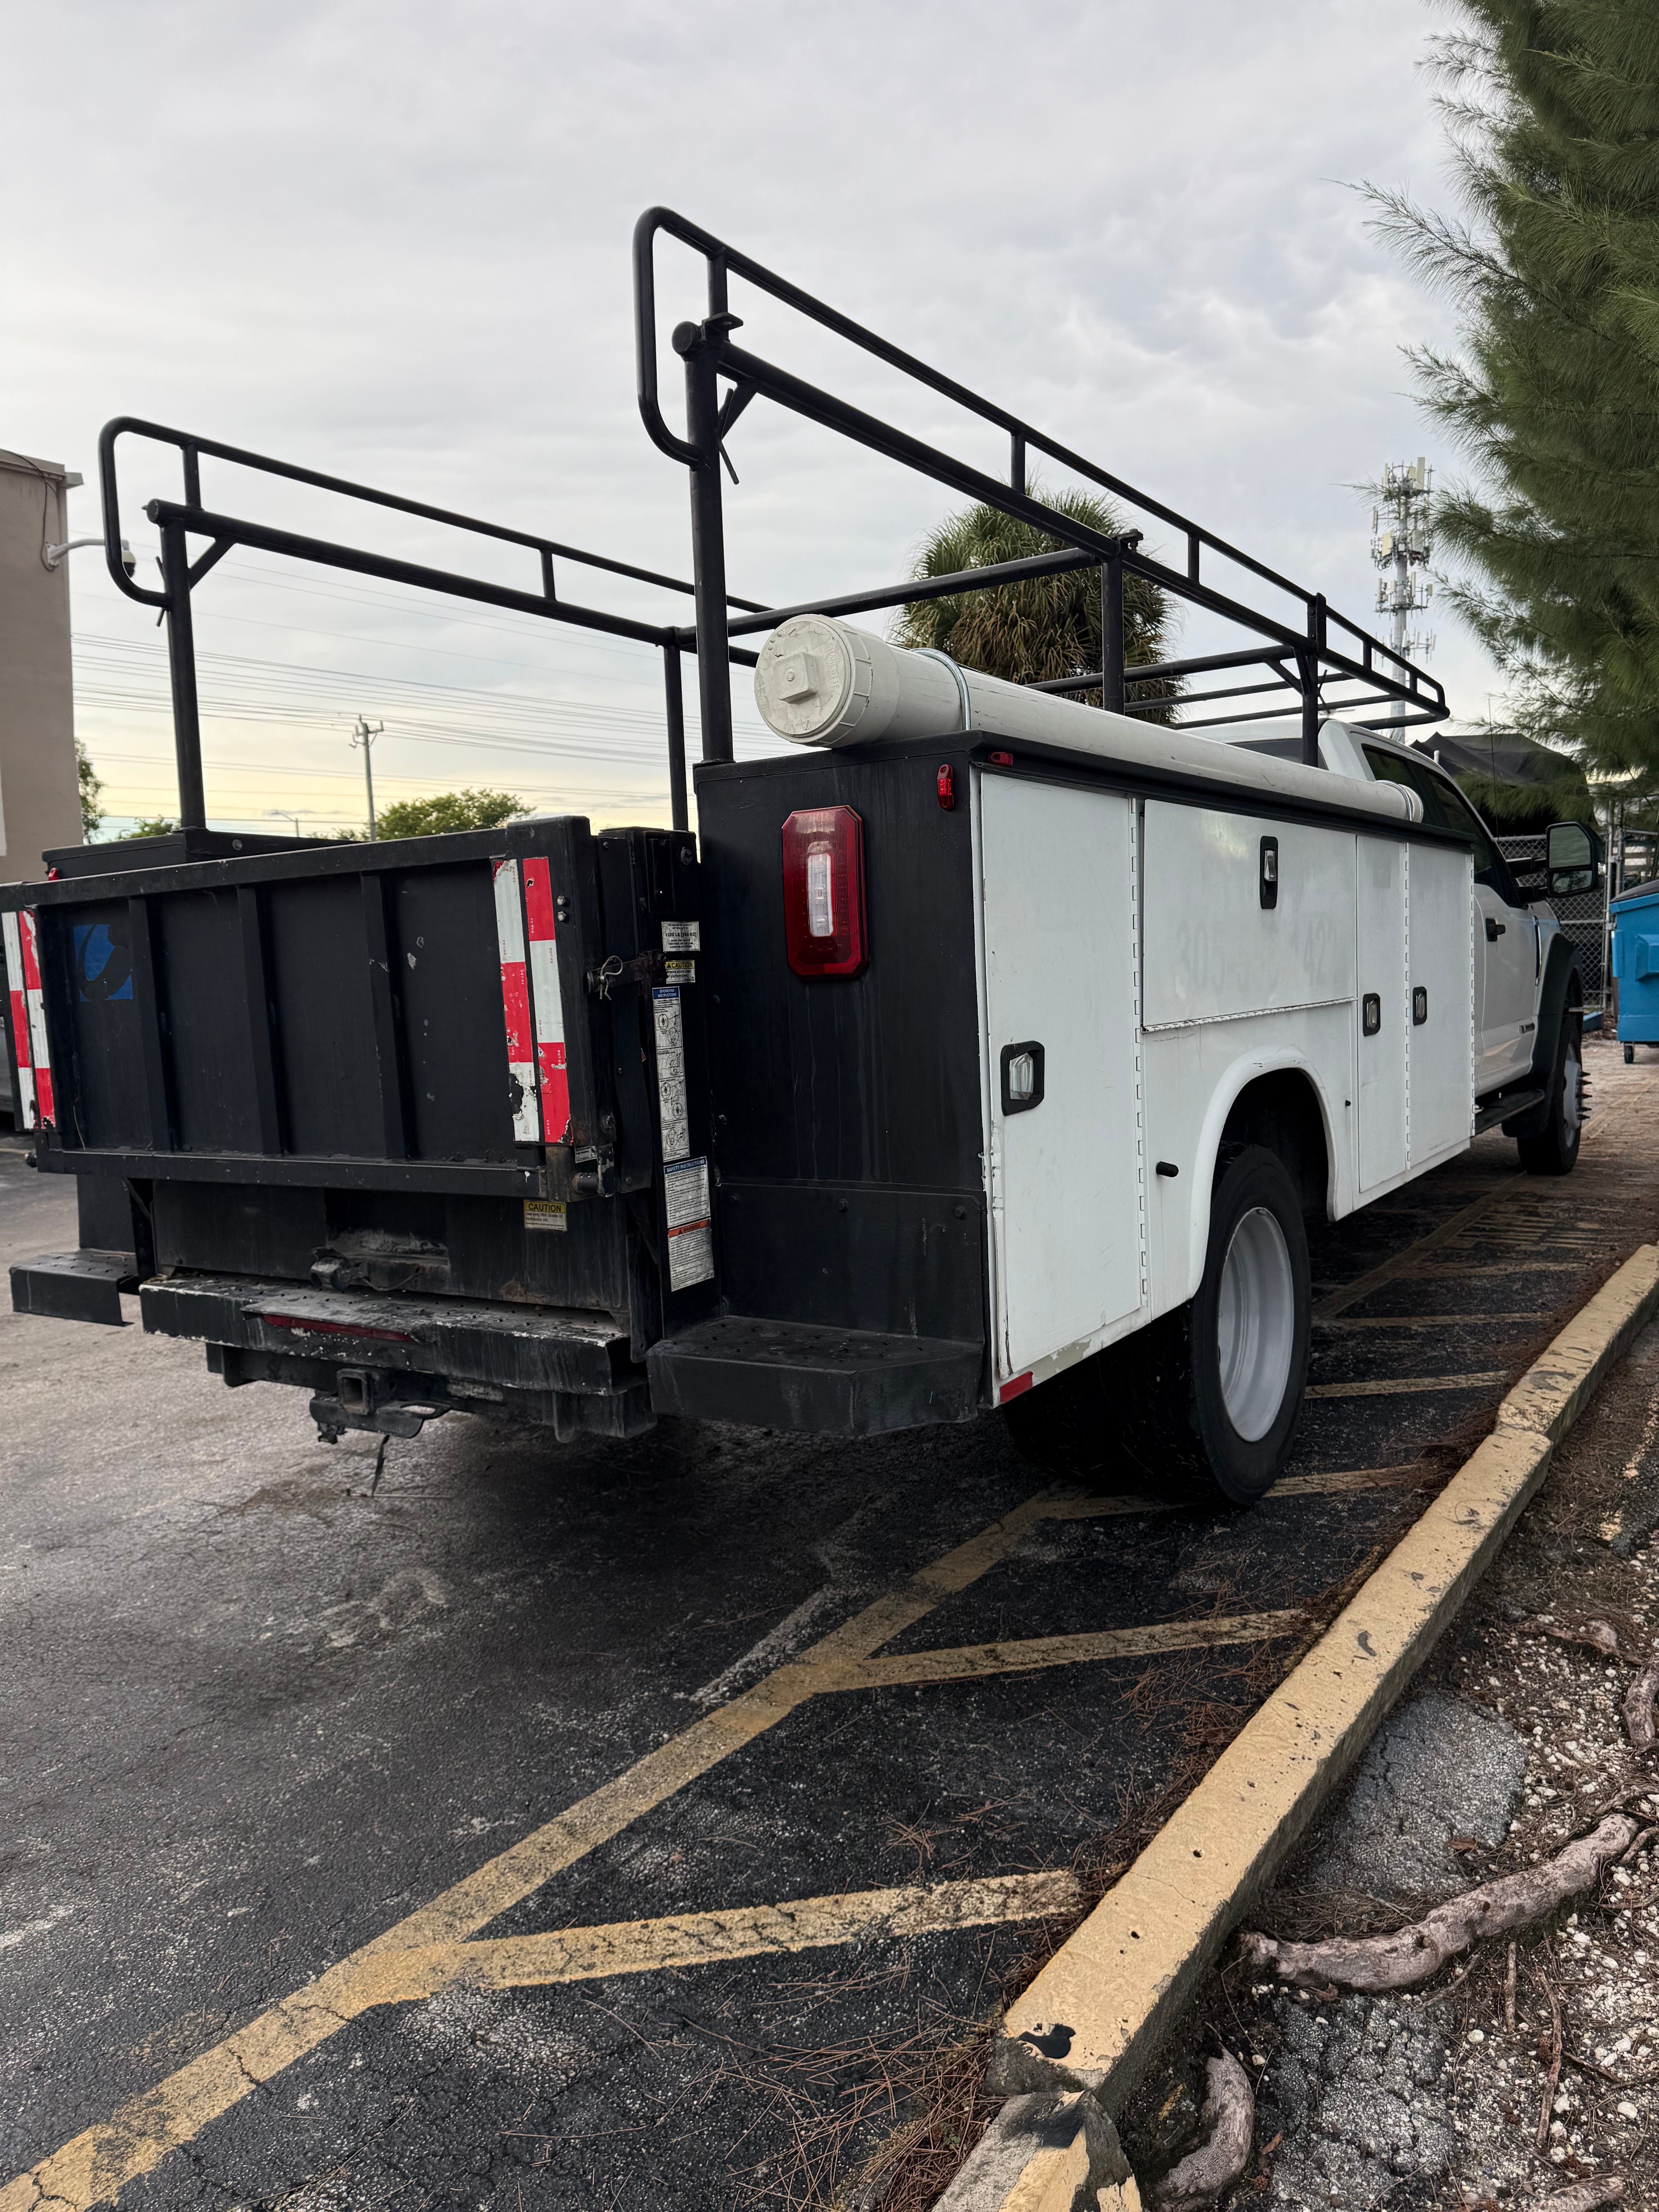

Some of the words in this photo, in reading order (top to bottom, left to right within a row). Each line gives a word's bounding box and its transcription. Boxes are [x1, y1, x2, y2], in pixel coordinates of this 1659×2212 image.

[827, 643, 840, 689] CHARLOTTE
[680, 1159, 705, 1169] INSTRUCTIONS
[528, 1203, 561, 1212] CAUTION
[683, 1223, 701, 1231] WARNING
